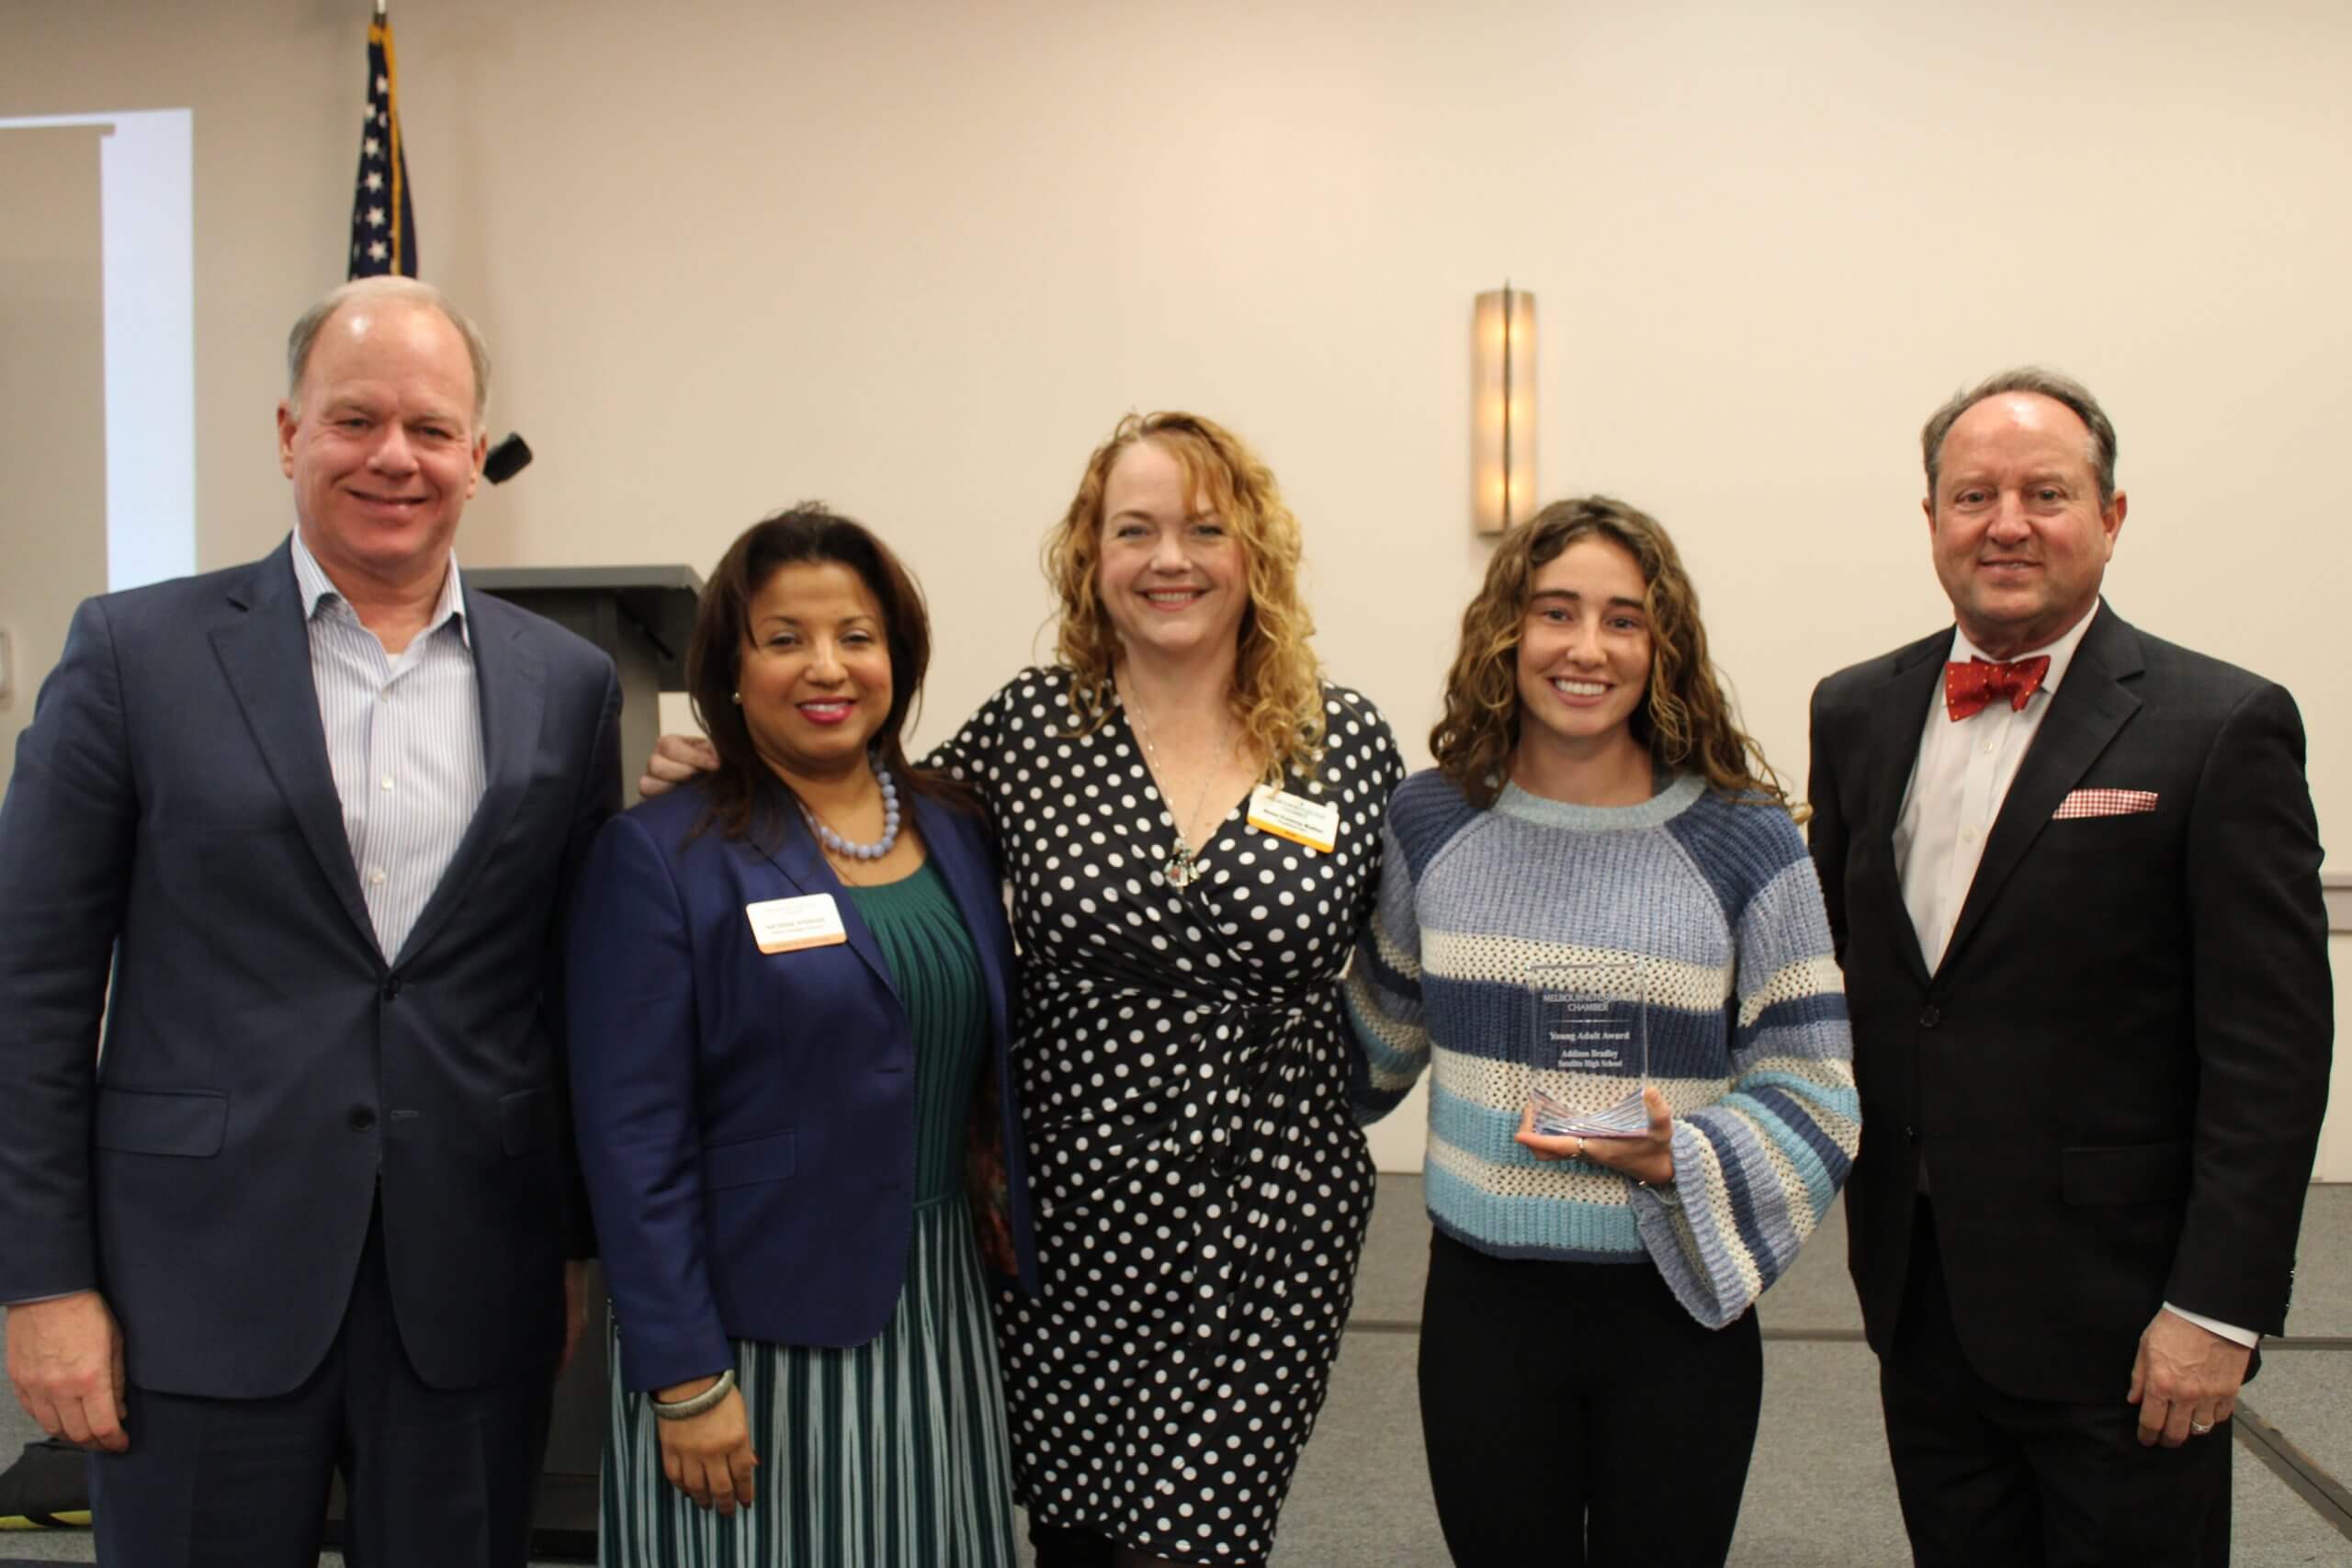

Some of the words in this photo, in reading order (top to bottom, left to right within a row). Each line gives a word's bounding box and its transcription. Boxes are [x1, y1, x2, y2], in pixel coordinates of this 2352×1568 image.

[1549, 1032, 1577, 1043] Young
[1577, 1032, 1600, 1040] Adult
[1601, 1032, 1630, 1040] Award
